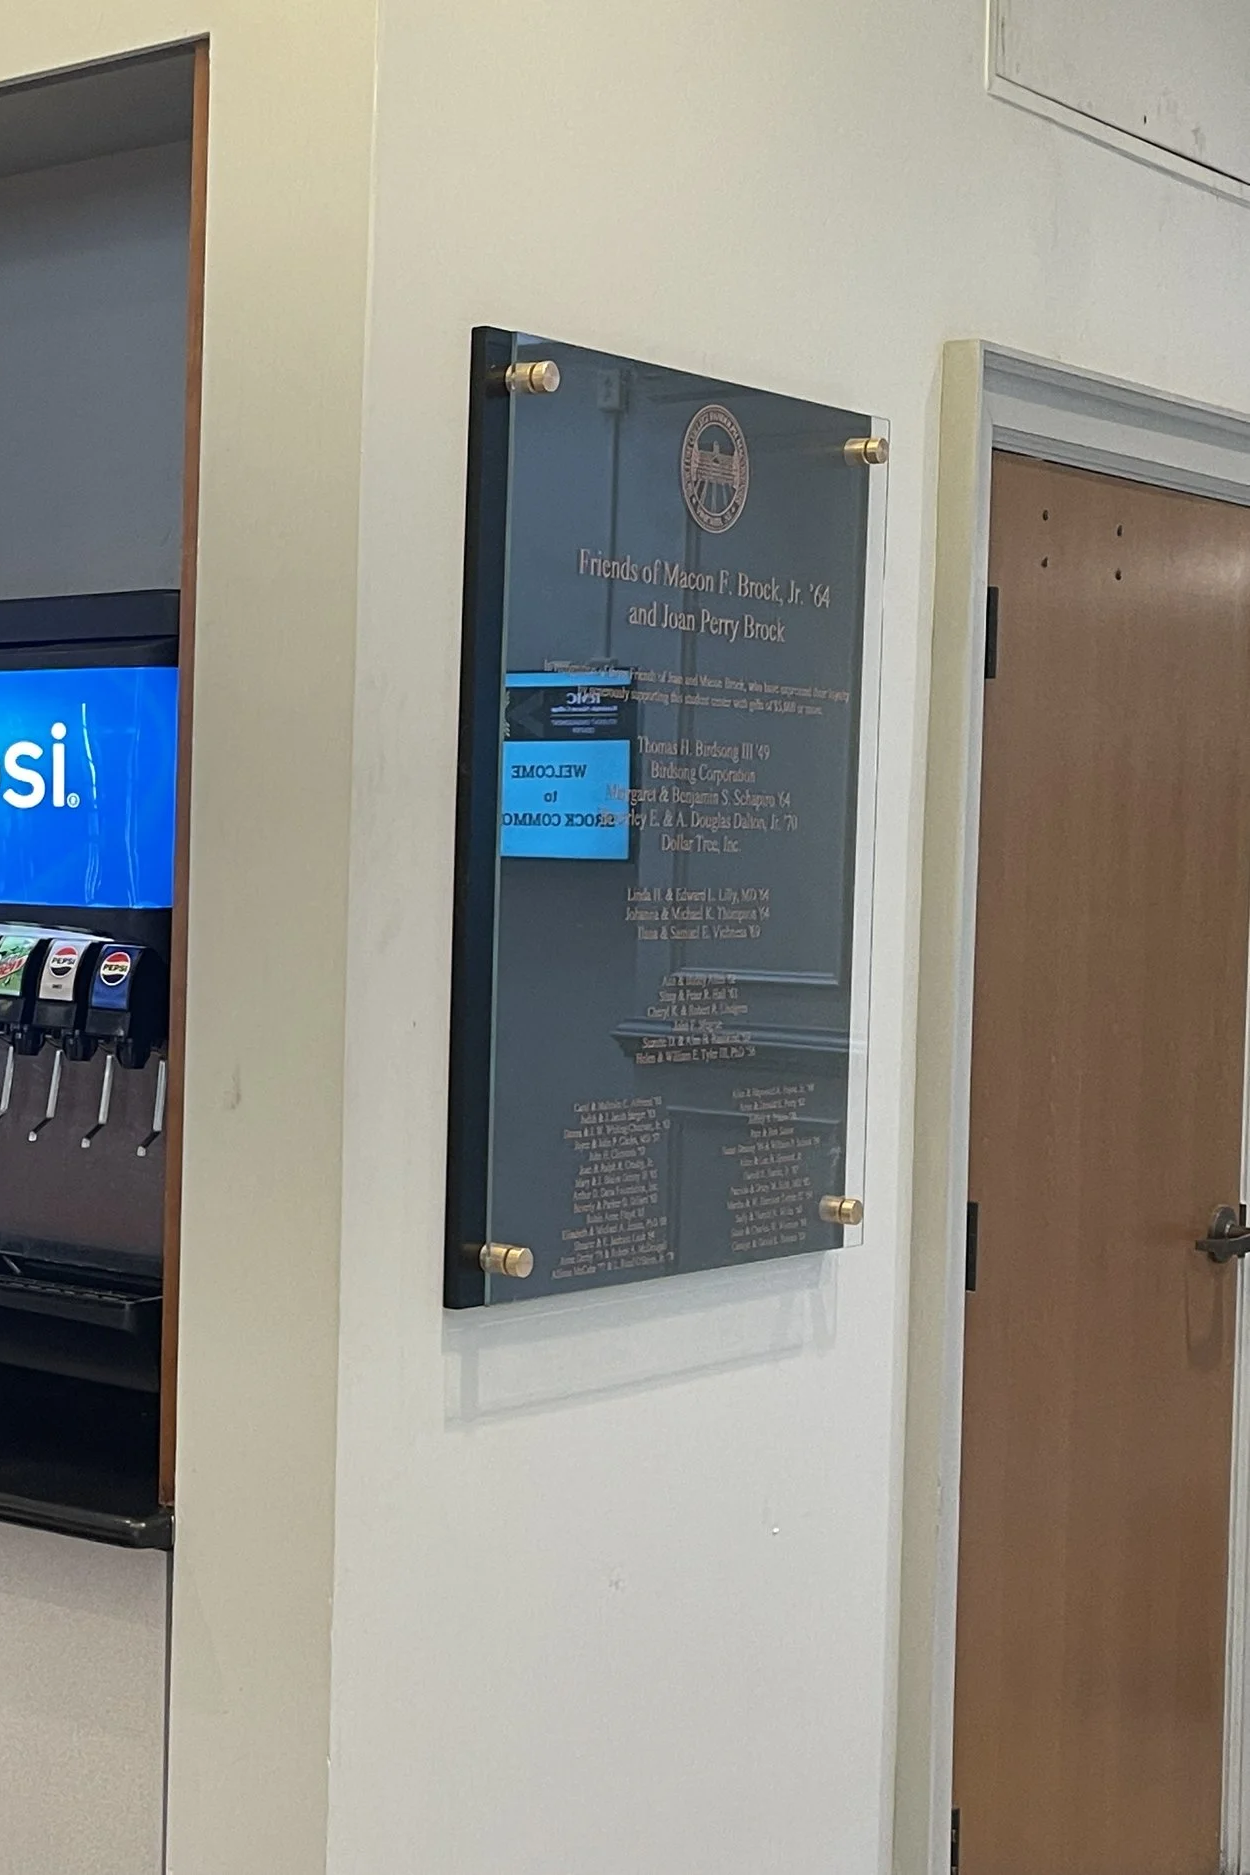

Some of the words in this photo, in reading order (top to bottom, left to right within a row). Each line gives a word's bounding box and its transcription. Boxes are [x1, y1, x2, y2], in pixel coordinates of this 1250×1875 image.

[578, 548, 638, 582] Friends
[642, 559, 660, 584] of
[663, 560, 714, 592] Macon
[719, 569, 733, 597] F.
[737, 572, 784, 606] Brock,
[786, 580, 804, 604] Jr.
[629, 601, 657, 627] and
[661, 603, 696, 632] Joan
[700, 608, 740, 643] Perry
[744, 614, 786, 643] Brock
[637, 736, 678, 756] Thomas
[695, 740, 739, 764] Birdsong
[651, 759, 696, 783] Birdsong
[699, 763, 756, 786] Corporation
[659, 786, 669, 802] &
[672, 787, 719, 807] Benjamin
[663, 811, 673, 828] &
[691, 812, 731, 833] Douglas
[661, 834, 693, 853] Dollar
[51, 956, 75, 965] PEPSI
[103, 963, 128, 972] PEPSI
